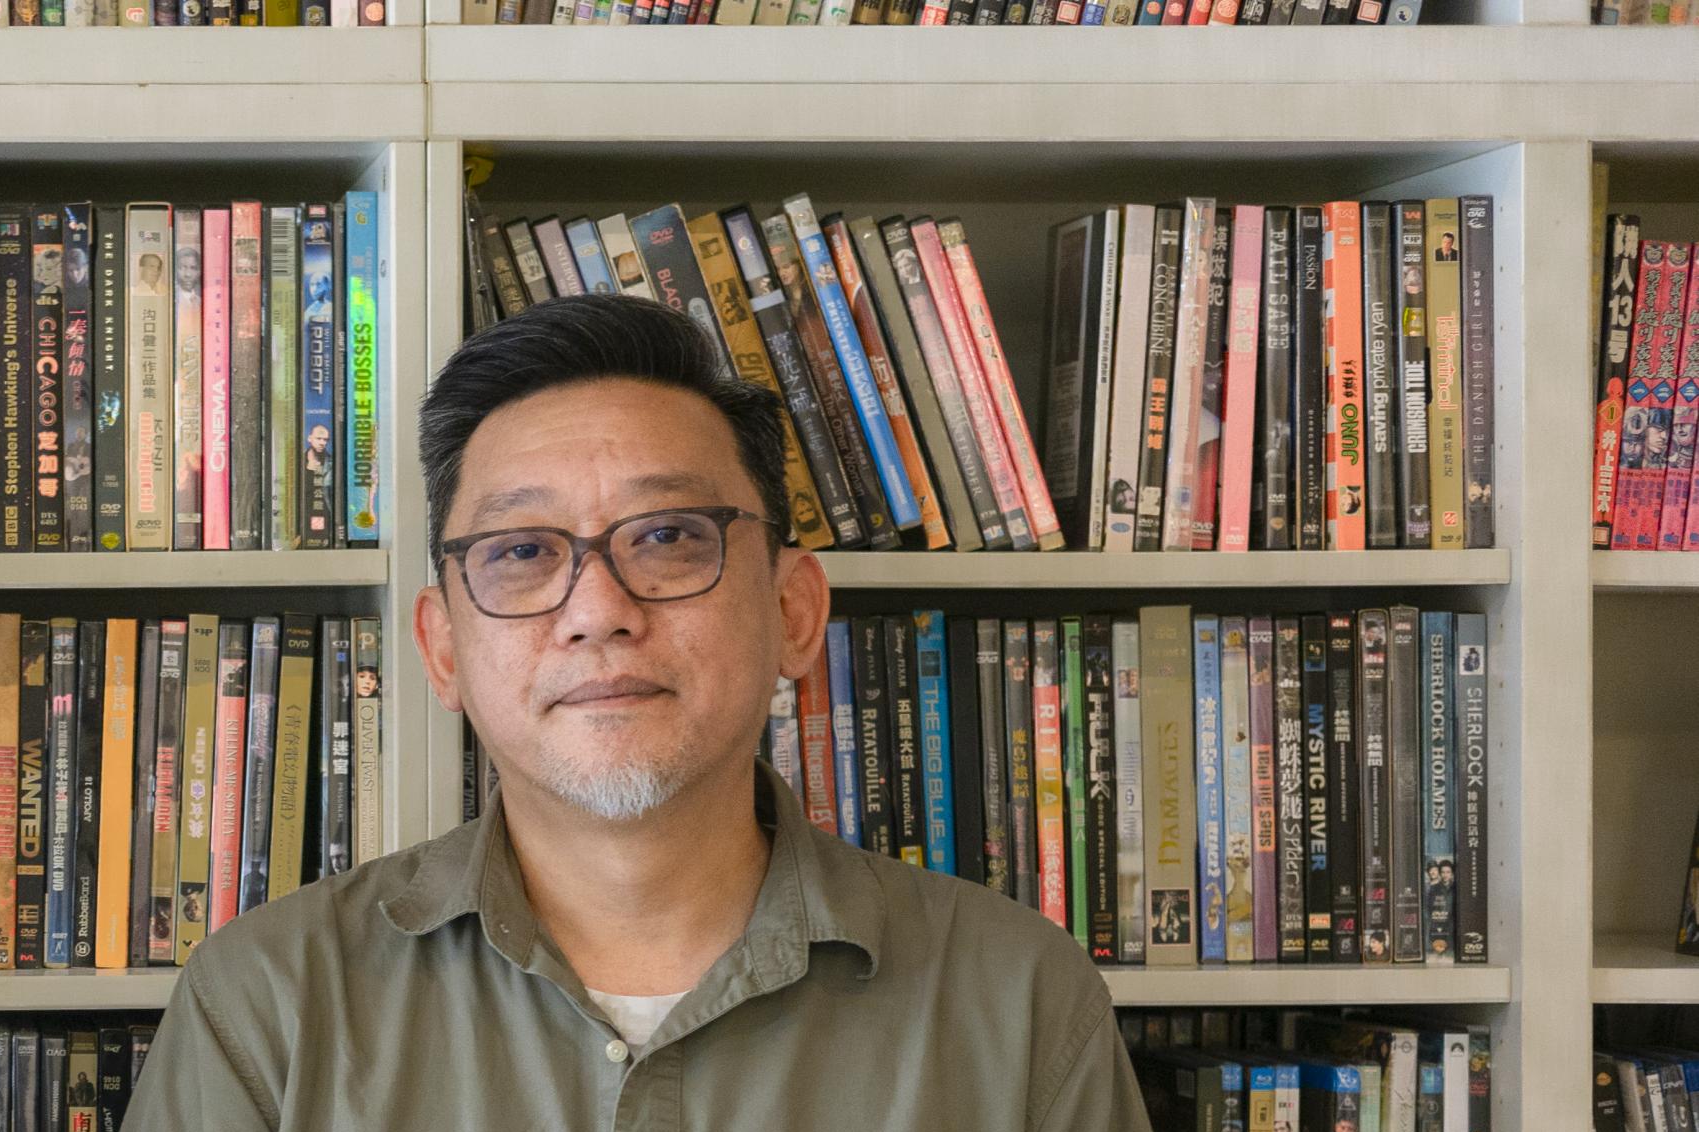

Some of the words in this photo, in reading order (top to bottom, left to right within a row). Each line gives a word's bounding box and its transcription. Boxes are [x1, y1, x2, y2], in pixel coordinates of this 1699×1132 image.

[104, 232, 113, 260] THE
[1268, 228, 1288, 286] FAIL
[1304, 244, 1316, 291] PASSION
[4, 278, 20, 345] Universe
[104, 268, 113, 307] DARK
[1151, 263, 1168, 357] CONCUBINE
[1267, 293, 1290, 350] SAFE
[1375, 301, 1388, 337] ryan
[1472, 319, 1484, 352] GIRL
[36, 316, 59, 427] CHICAGO
[354, 322, 373, 392] BOSSES
[1374, 338, 1389, 389] private
[1404, 360, 1426, 396] TIDE
[4, 357, 22, 430] Hawking's
[1472, 361, 1484, 426] DANISH
[209, 379, 226, 473] CINEMA
[354, 399, 373, 489] HORRIBLE
[821, 393, 840, 418] The
[841, 450, 869, 498] Woman
[1340, 402, 1359, 466] JUNO
[1372, 393, 1389, 454] saving
[1406, 399, 1428, 454] CRIMSON
[1472, 433, 1484, 463] THE
[4, 445, 20, 495] Stephen
[923, 680, 941, 731] THE
[1429, 633, 1445, 739] SHERLOCK
[226, 718, 239, 766] KILLING
[360, 705, 376, 754] OLIVER
[804, 713, 828, 738] THE
[927, 734, 942, 771] BIG
[1087, 691, 1111, 800] HULK
[1308, 704, 1326, 790] MYSTIC
[1466, 686, 1484, 787] SHERLOCK
[84, 776, 93, 787] 18
[225, 770, 238, 787] ME
[361, 755, 378, 793] TWIST
[807, 738, 834, 824] INCREDIBLES
[861, 707, 881, 813] RATATOUILLE
[1256, 749, 1270, 783] that
[1430, 745, 1446, 832] HOLMES
[20, 738, 42, 859] WANTED
[84, 788, 93, 823] APOLLO
[223, 792, 237, 837] SOFTLY
[929, 775, 946, 840] BLUE
[1157, 720, 1182, 866] DAMAGES
[1258, 790, 1270, 807] all
[1258, 810, 1272, 848] she's
[1309, 795, 1327, 871] RIVER
[78, 875, 90, 938] RubberBand
